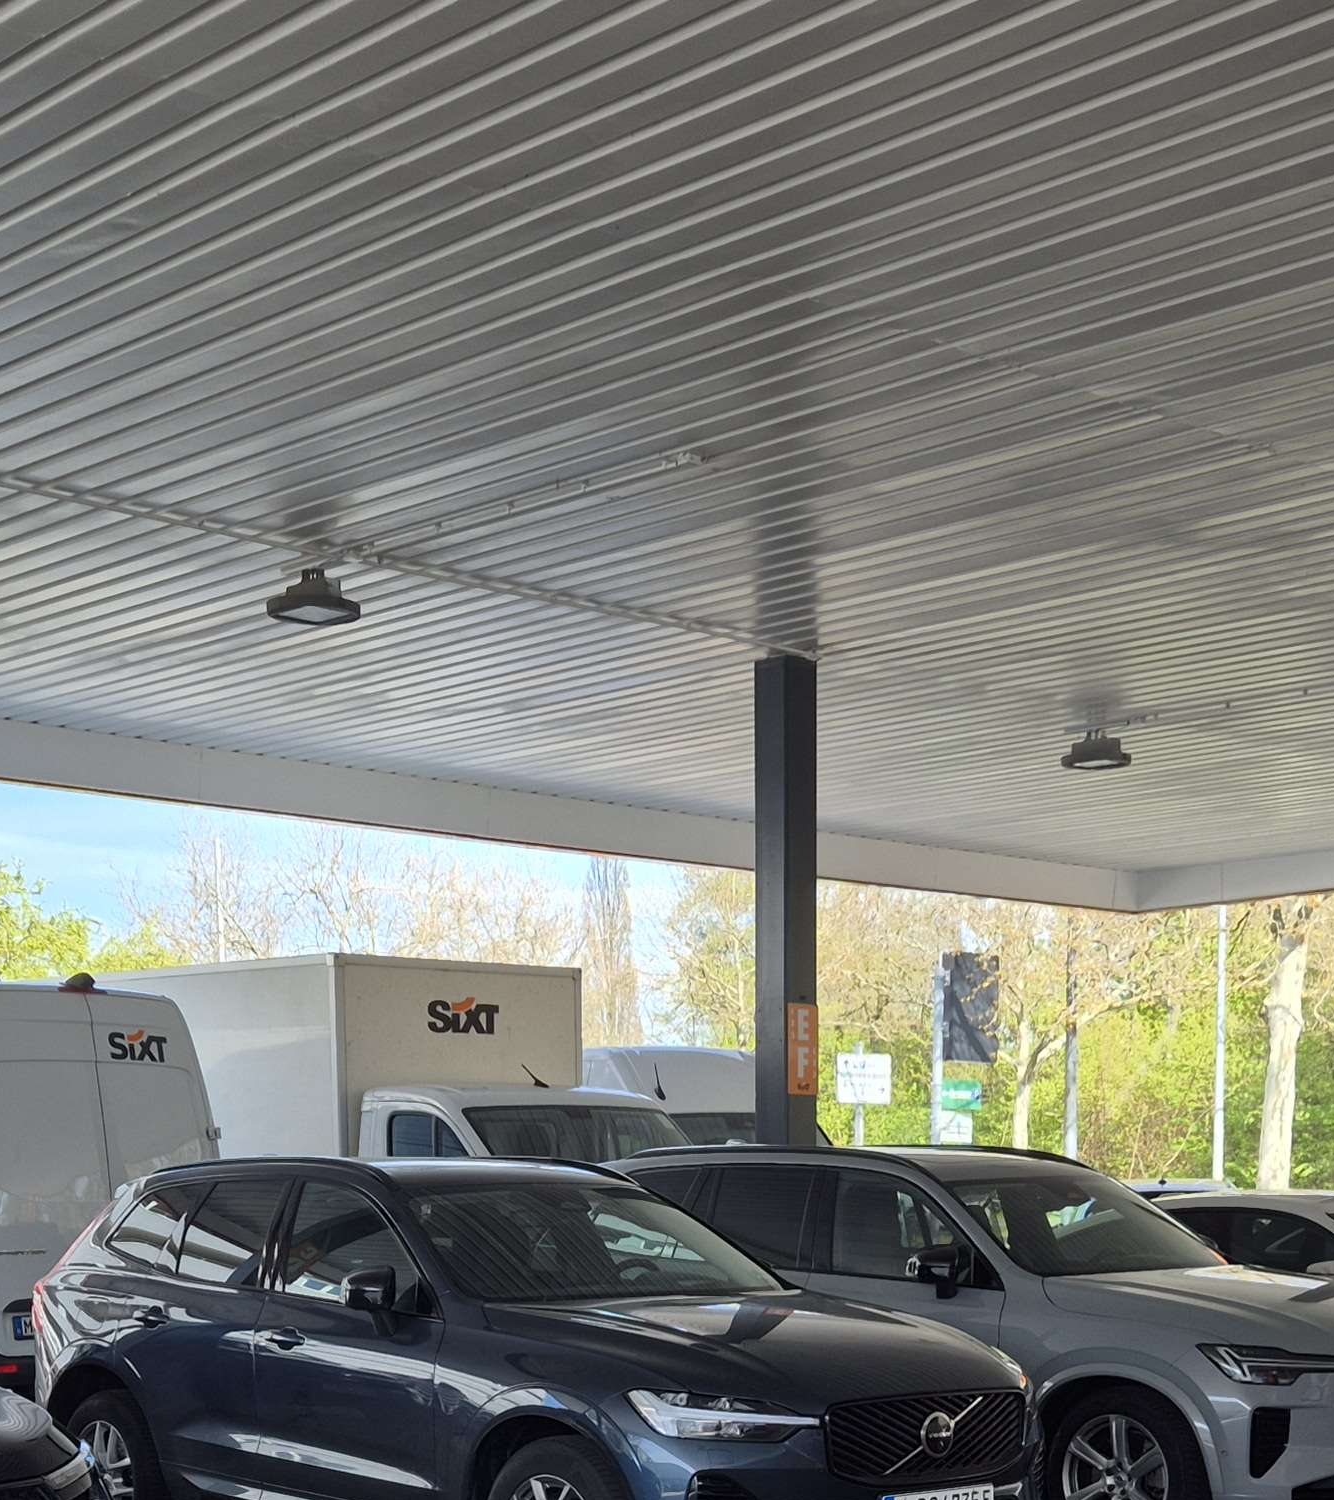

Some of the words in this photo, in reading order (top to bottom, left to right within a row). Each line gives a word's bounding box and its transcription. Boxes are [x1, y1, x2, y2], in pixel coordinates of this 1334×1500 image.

[428, 996, 499, 1035] SIXT
[797, 1009, 809, 1041] E
[108, 1029, 167, 1063] SIXT
[797, 1047, 809, 1078] F
